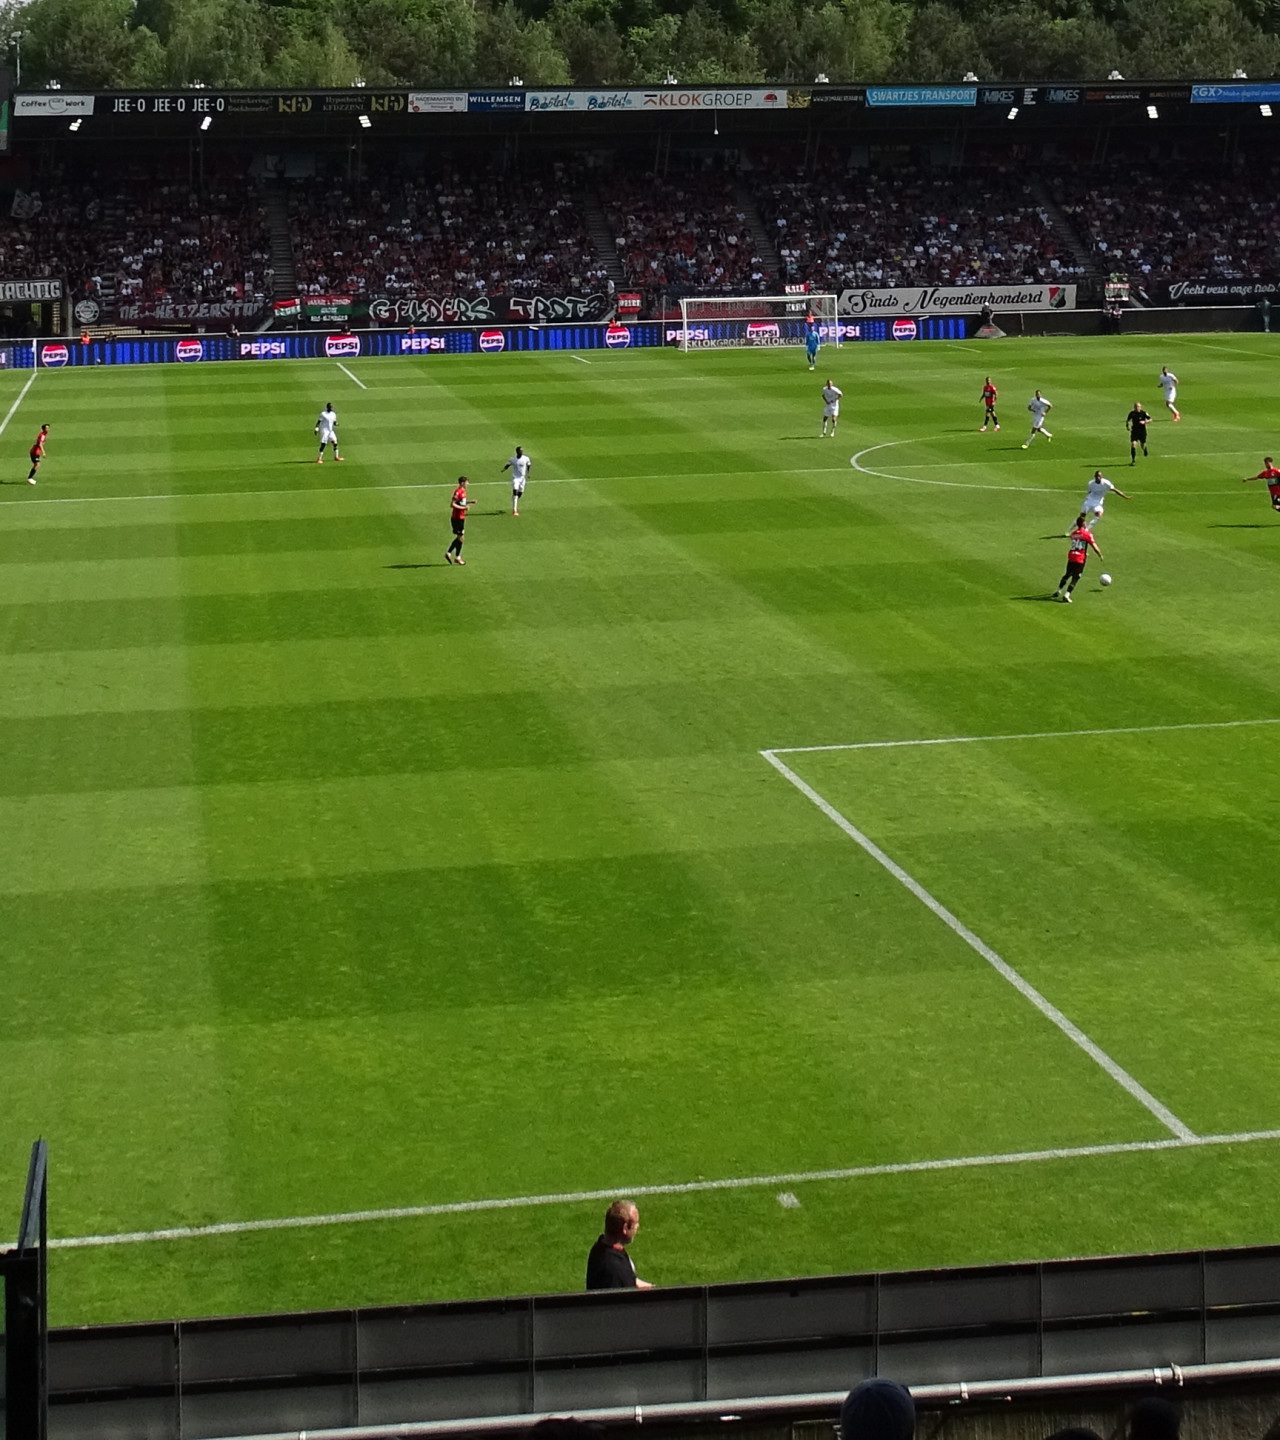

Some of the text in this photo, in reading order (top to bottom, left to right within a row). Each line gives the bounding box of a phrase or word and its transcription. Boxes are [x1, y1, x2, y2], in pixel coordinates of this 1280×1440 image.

[658, 93, 753, 107] KLOKGROEP
[872, 91, 919, 101] SWARTJES
[921, 90, 976, 101] TRANSPORT
[21, 99, 86, 108] Coffee Work
[113, 97, 225, 112] JEE-O JEE-O JEE-O
[1169, 281, 1205, 300] Vecht
[848, 288, 1043, 314] Sinds Negentienhonderd
[370, 296, 495, 323] GELDERS
[666, 329, 709, 341] PEPSI
[748, 329, 778, 337] PEPSI
[818, 325, 861, 337] PEPSI
[401, 337, 445, 350] PEPSI
[481, 338, 503, 346] PEPSI
[607, 334, 629, 342] PEPSI
[241, 342, 286, 355] PEPSI
